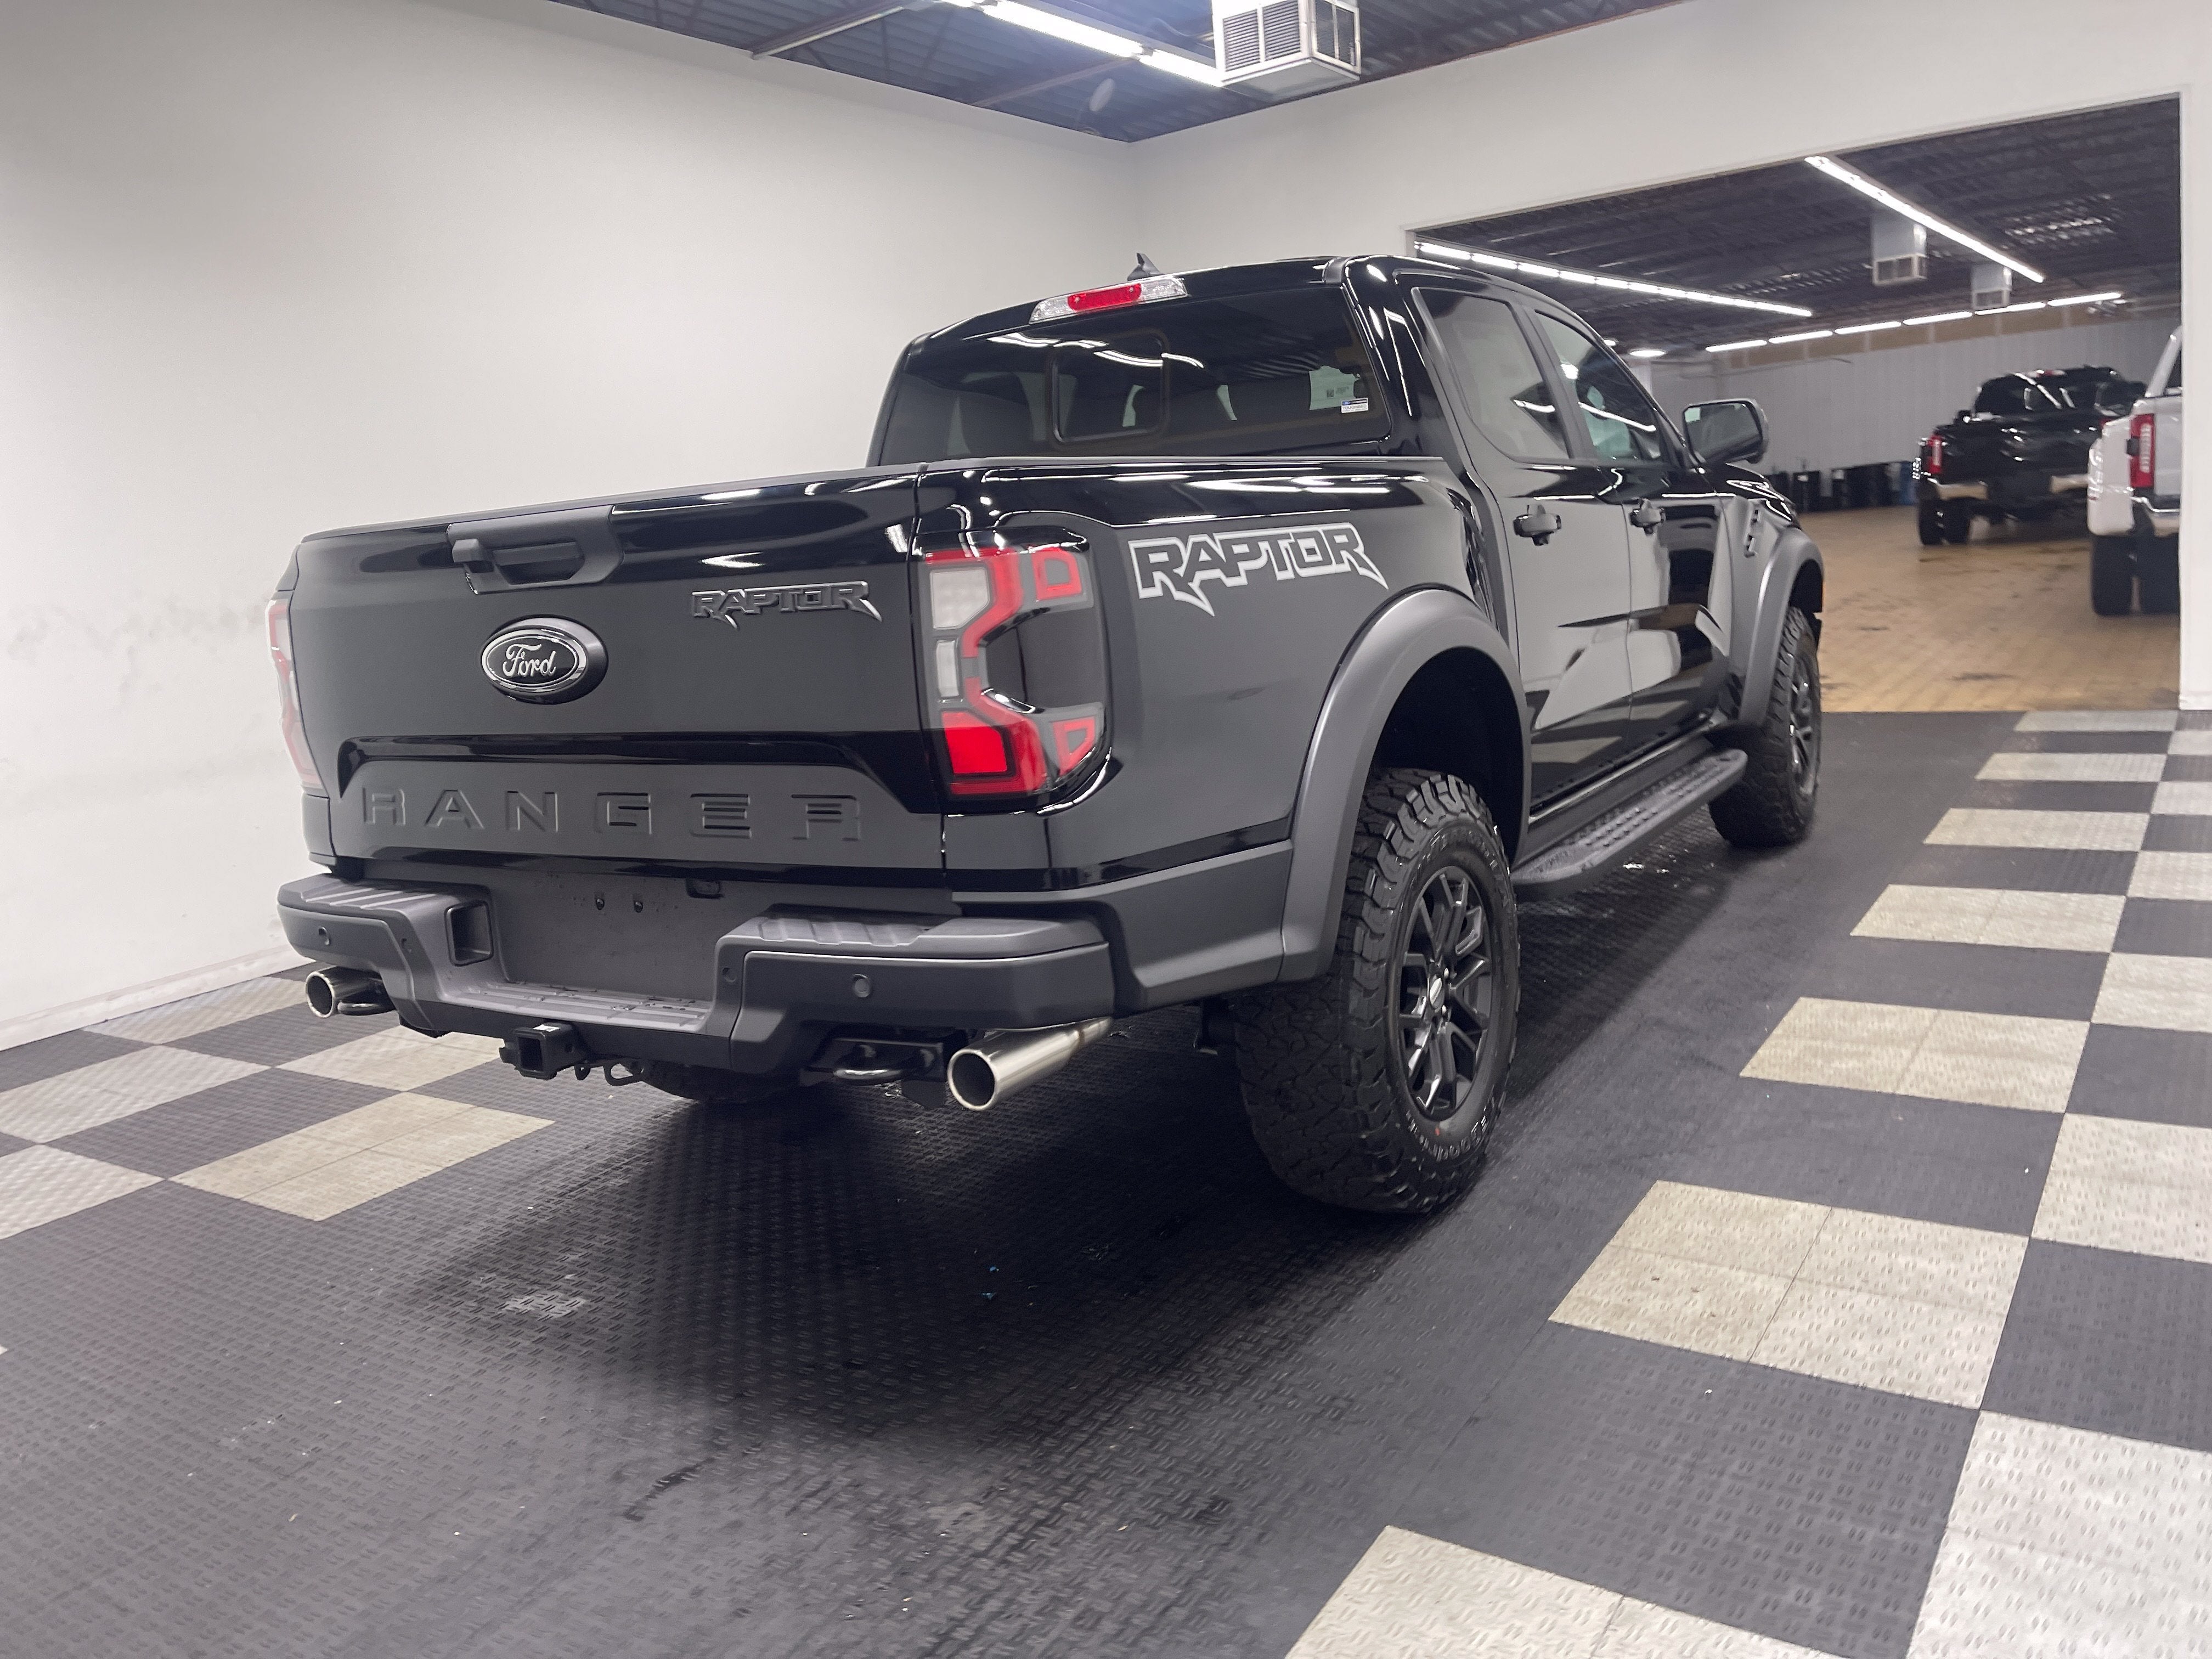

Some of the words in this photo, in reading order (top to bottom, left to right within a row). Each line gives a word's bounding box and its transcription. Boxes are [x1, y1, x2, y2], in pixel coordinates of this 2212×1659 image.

[1128, 522, 1389, 617] RAPTOR
[692, 580, 882, 629] RAPTOR
[502, 644, 556, 678] Ford
[362, 786, 861, 842] RANGER
